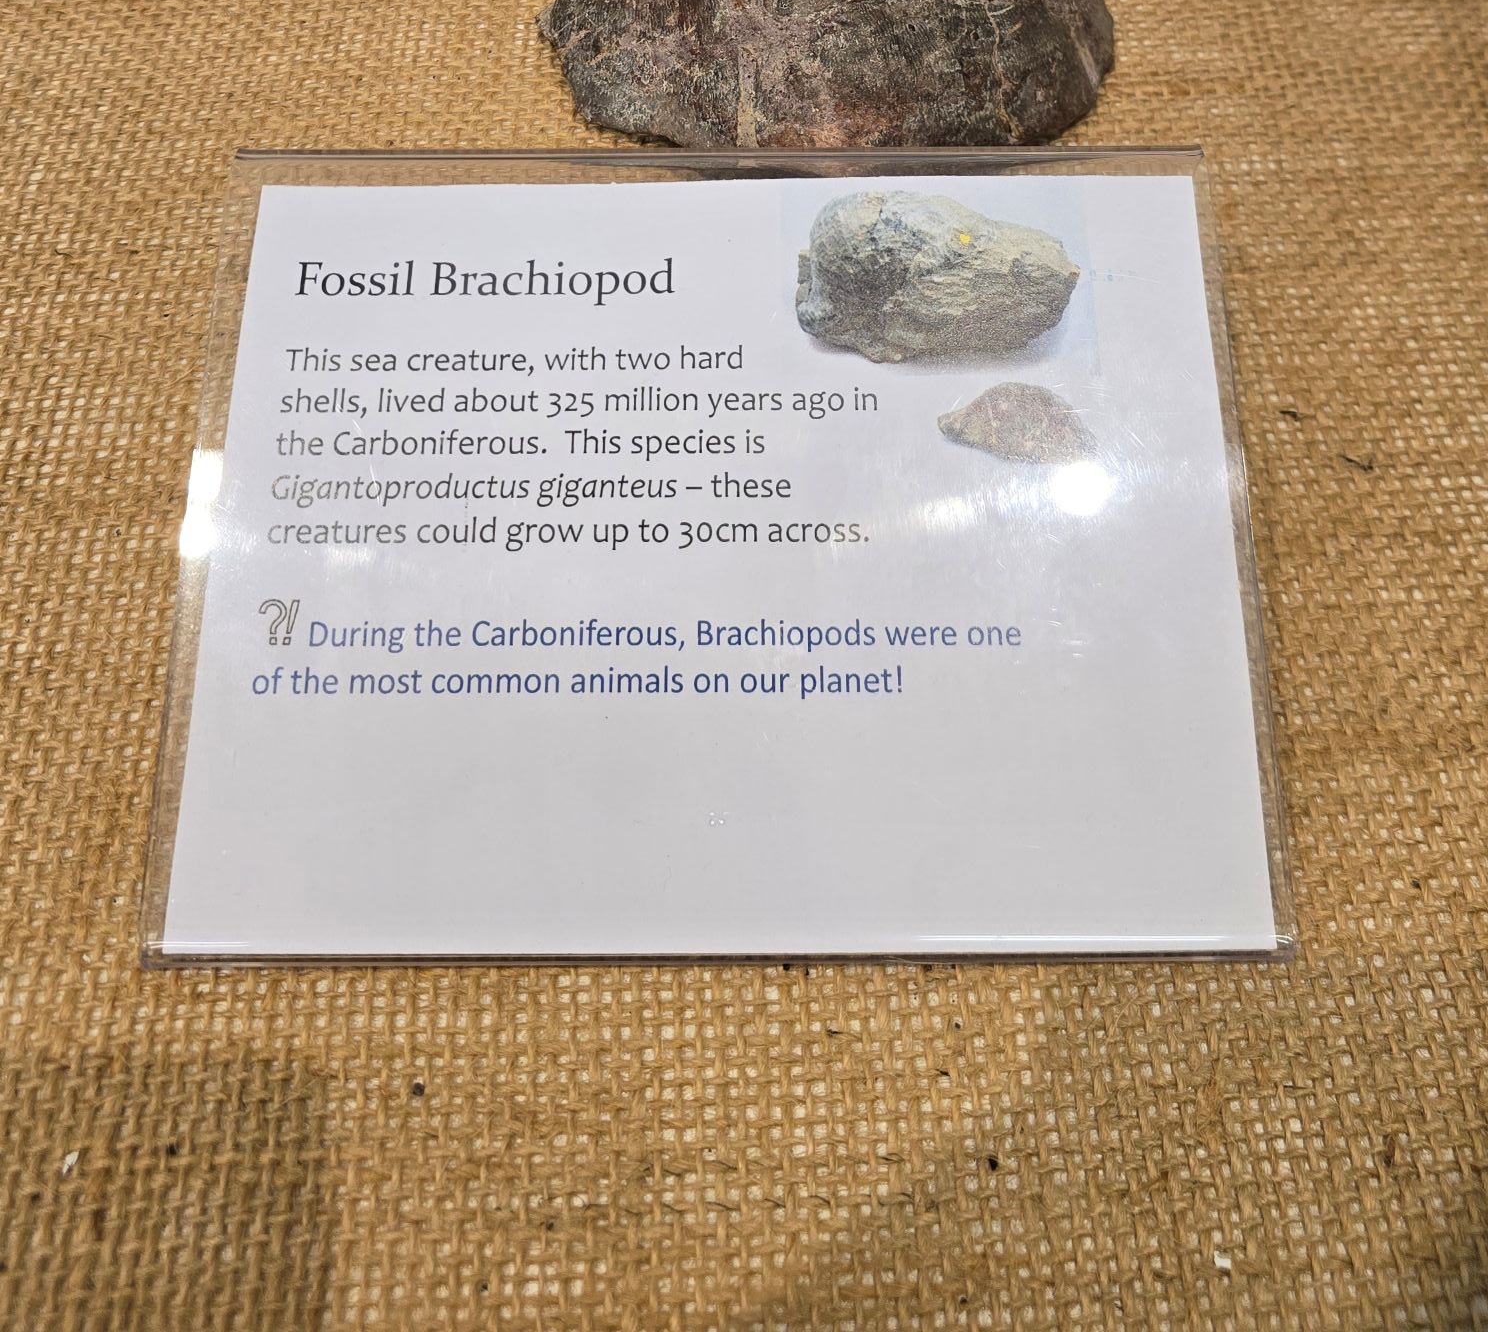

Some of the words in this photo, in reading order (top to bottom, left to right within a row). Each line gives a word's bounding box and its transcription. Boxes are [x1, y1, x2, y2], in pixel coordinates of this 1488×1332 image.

[294, 259, 415, 297] Fossil
[429, 257, 676, 307] Brachiopod
[285, 346, 342, 372] This
[349, 353, 397, 372] sea
[406, 349, 535, 377] creature,
[544, 345, 607, 371] with
[614, 348, 671, 371] two
[680, 344, 743, 370] hard
[279, 387, 368, 420] shells,
[377, 386, 446, 413] lived
[453, 386, 539, 413] about
[545, 392, 595, 419] 325
[604, 385, 699, 412] million
[707, 392, 783, 419] years
[791, 390, 845, 420] ago
[853, 386, 878, 412] in
[275, 429, 325, 457] the
[333, 428, 548, 457] Carboniferous.
[564, 427, 622, 455] This
[630, 428, 736, 462] species
[745, 428, 766, 455] is
[270, 472, 531, 509] Gigantoproductus
[536, 472, 678, 508] giganteus
[710, 471, 792, 499] these
[266, 520, 407, 545] creatures
[416, 515, 497, 546] could
[504, 521, 585, 553] grow
[593, 523, 630, 551] up
[637, 518, 670, 544] to
[677, 521, 758, 550] 30cm
[767, 522, 870, 544] across.
[308, 620, 406, 654] During
[413, 618, 462, 647] the
[471, 618, 685, 652] Carboniferous,
[696, 618, 876, 653] Brachiopods
[884, 625, 958, 646] were
[967, 625, 1022, 647] one
[252, 666, 285, 696] of
[290, 666, 339, 695] the
[349, 669, 423, 695] most
[431, 673, 560, 695] common
[570, 664, 684, 694] animals
[693, 672, 729, 694] on
[740, 672, 791, 694] our
[800, 664, 903, 701] planet!
